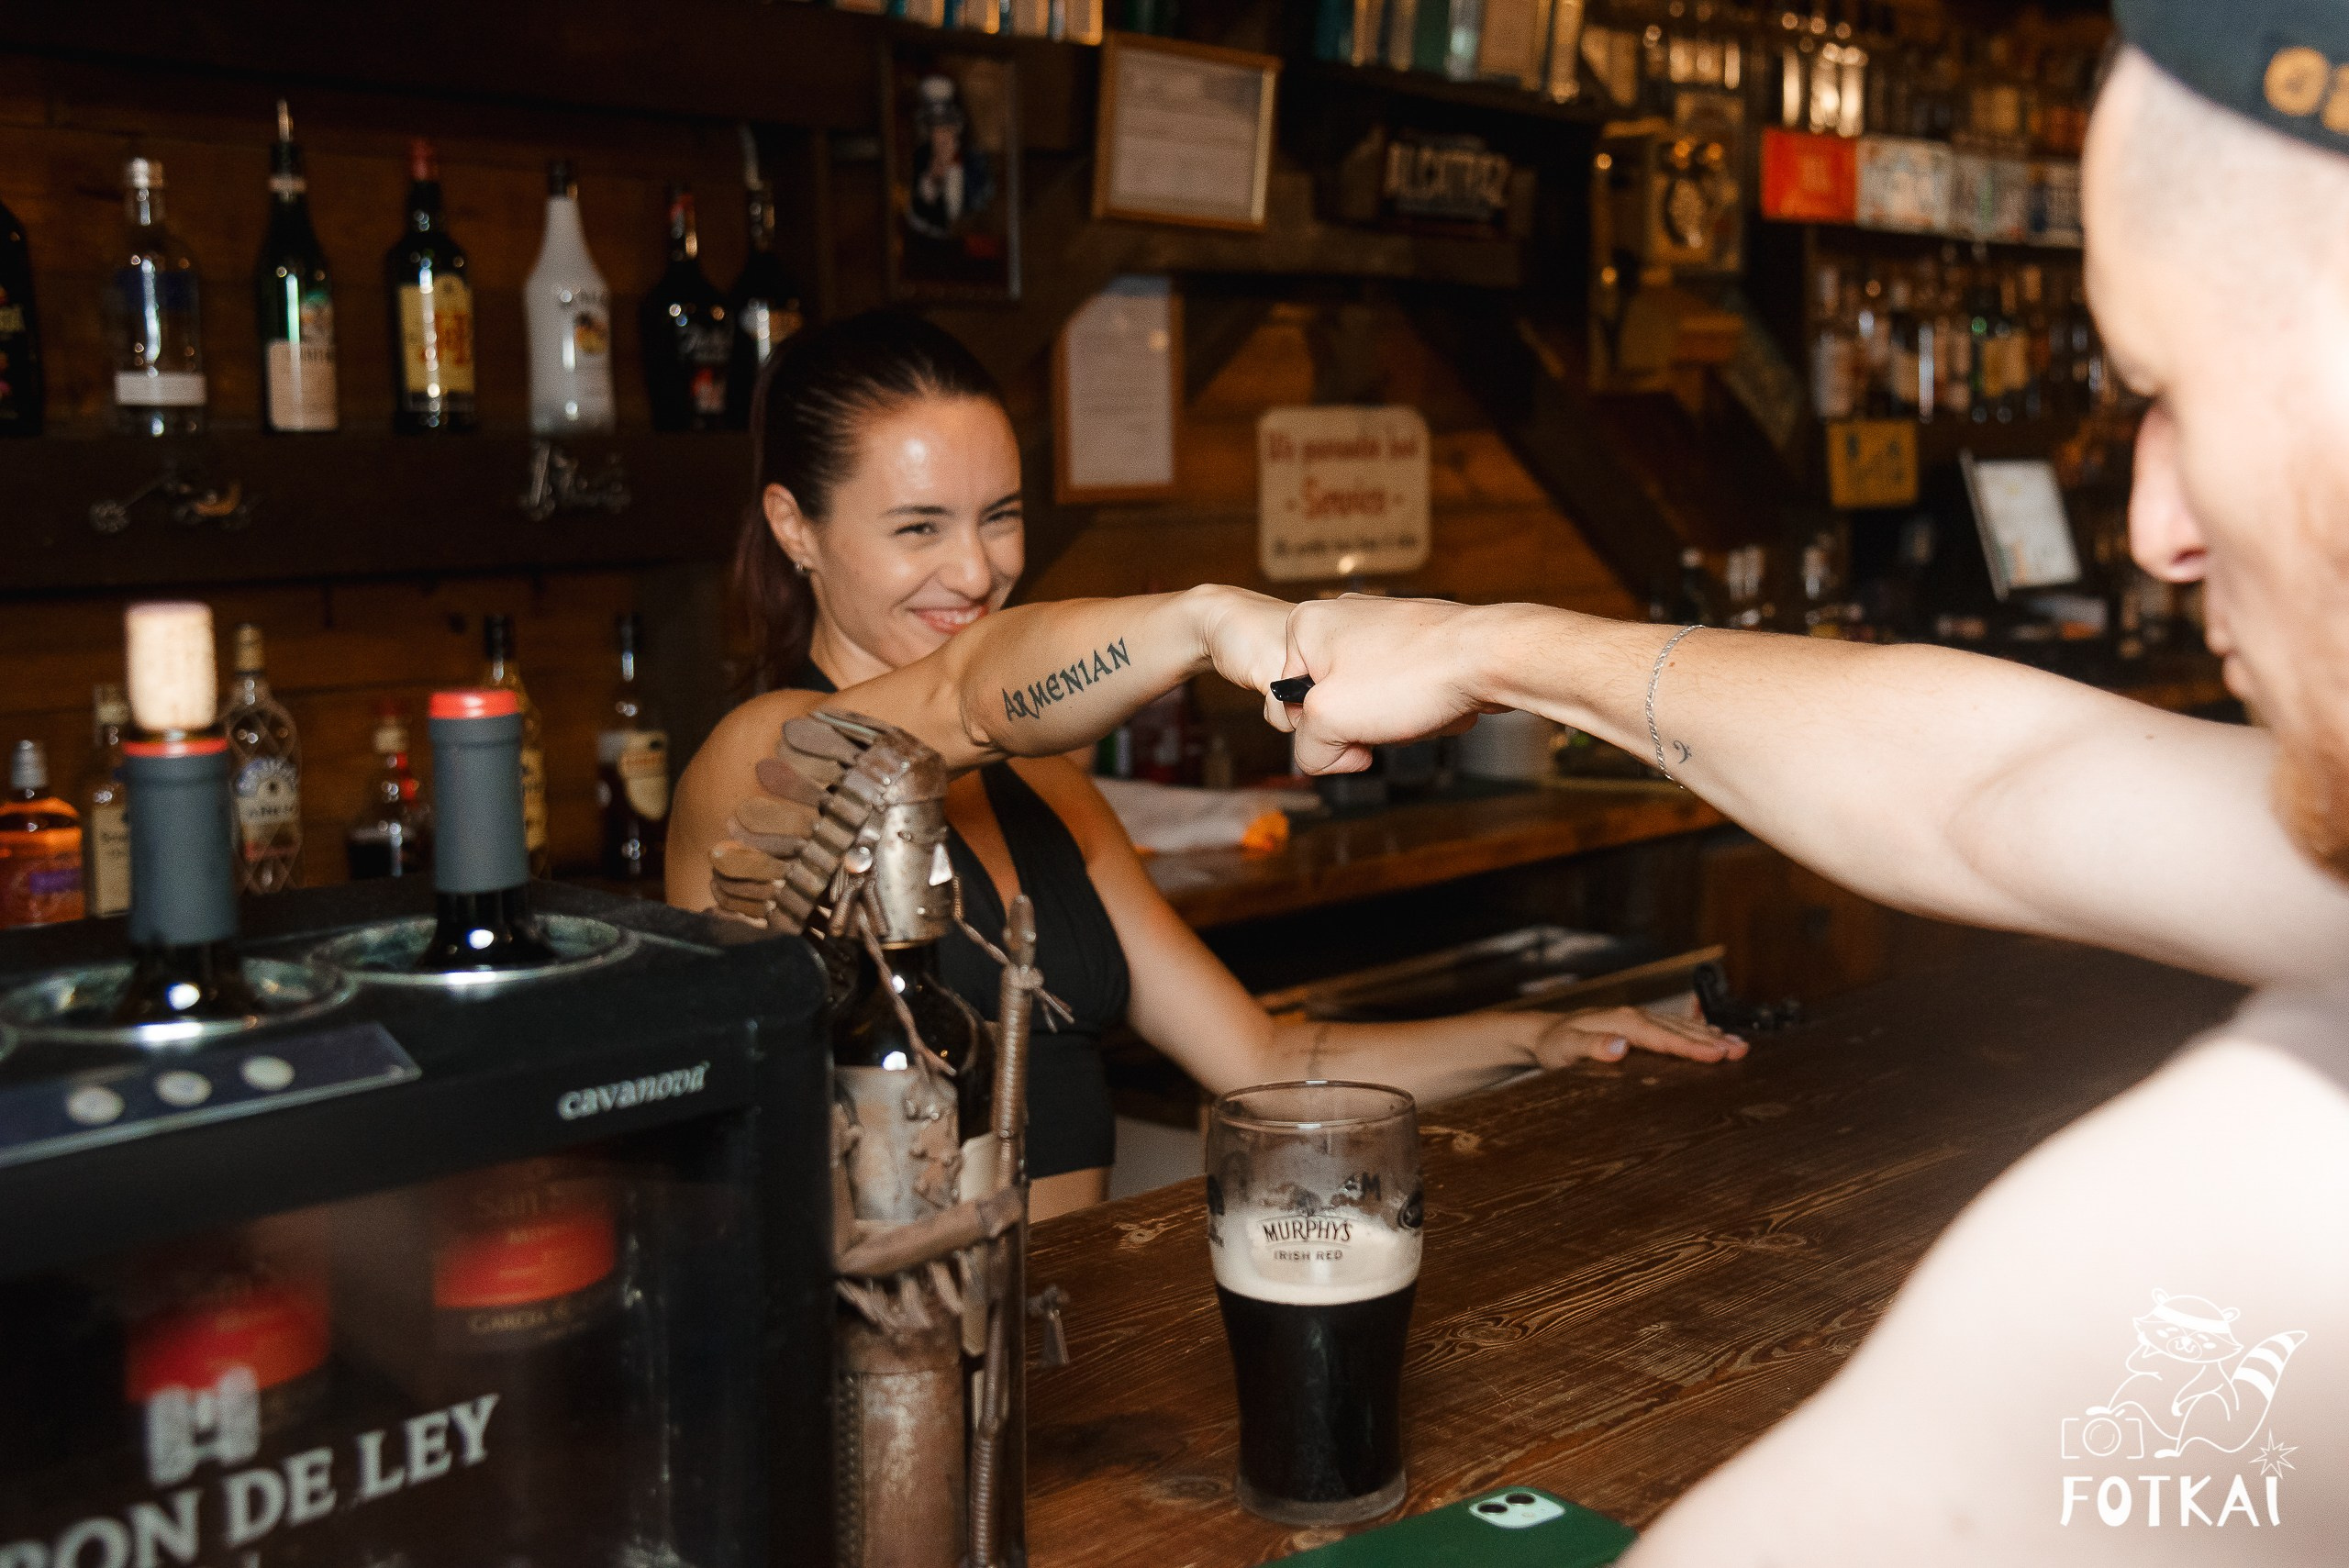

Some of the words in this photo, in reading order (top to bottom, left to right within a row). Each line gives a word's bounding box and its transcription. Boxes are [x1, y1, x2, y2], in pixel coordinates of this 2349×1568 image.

[557, 1064, 707, 1121] cavanova
[1274, 1250, 1310, 1261] IRISH
[1316, 1249, 1343, 1261] RED
[223, 1445, 338, 1548] DE
[355, 1393, 500, 1502] LEY
